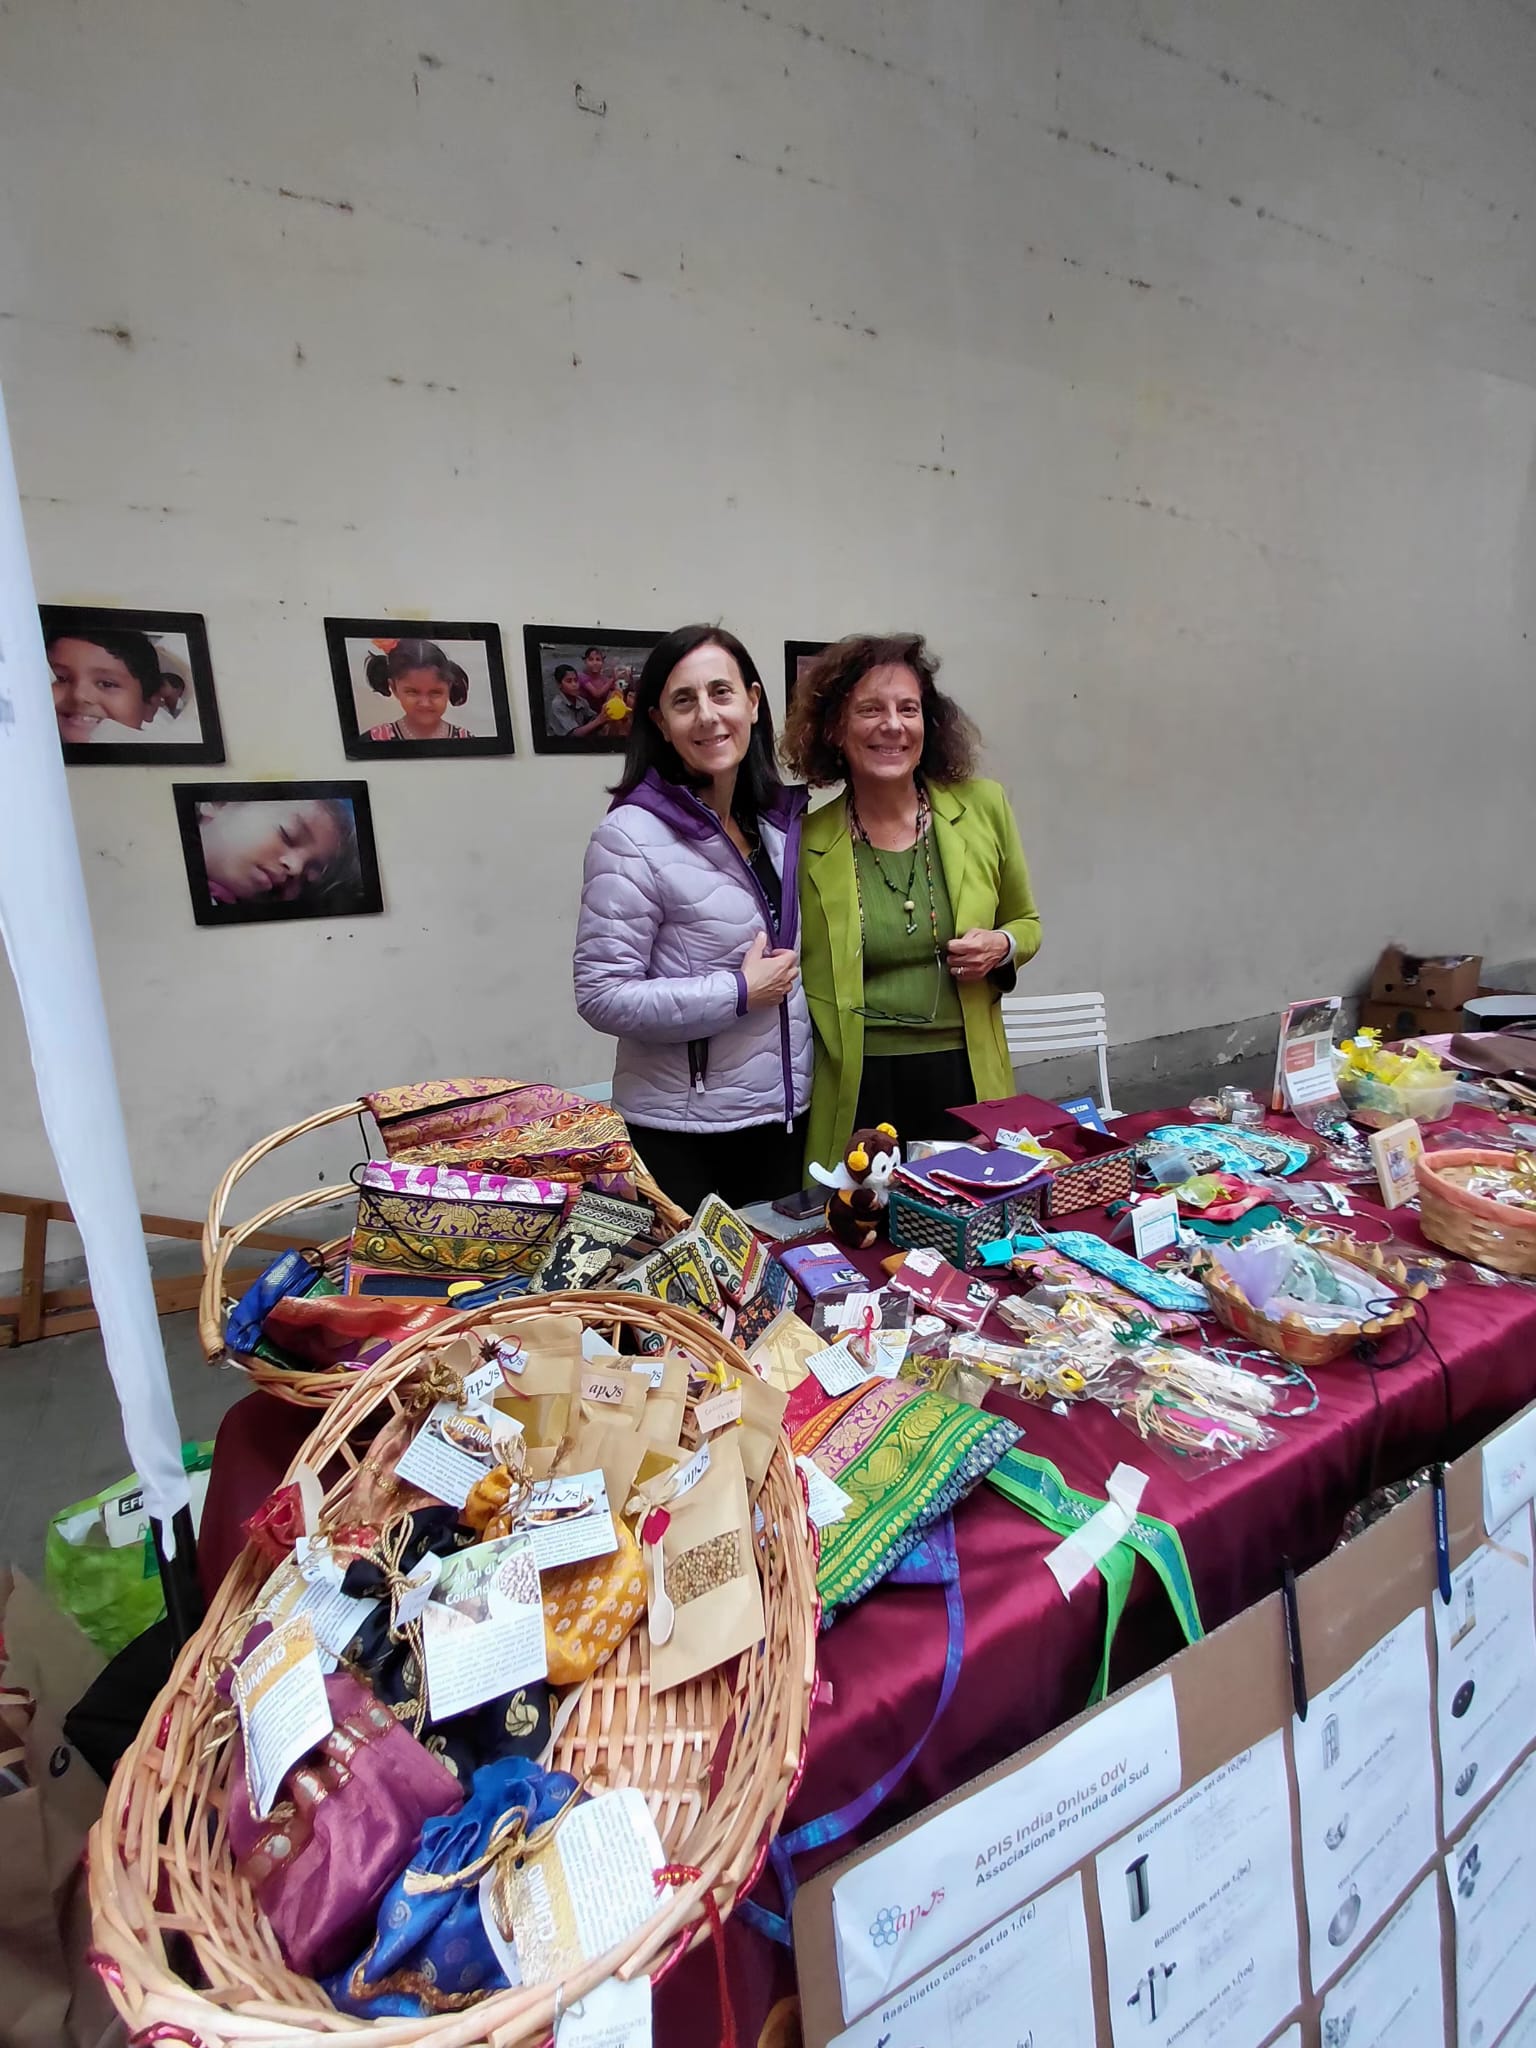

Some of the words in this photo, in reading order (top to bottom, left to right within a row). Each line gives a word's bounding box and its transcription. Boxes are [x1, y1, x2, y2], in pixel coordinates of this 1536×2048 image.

[974, 1836, 1014, 1871] APIS
[1015, 1811, 1054, 1844] India
[1056, 1783, 1099, 1817] Onlus
[1100, 1758, 1129, 1788] OdV
[975, 1828, 1056, 1887] Associazione
[1058, 1814, 1079, 1832] Pro
[1081, 1795, 1109, 1821] India
[1110, 1779, 1127, 1801] del
[1128, 1762, 1151, 1785] Sud
[1137, 1811, 1173, 1844] Bicchieri
[527, 1863, 558, 1942] CUMINO
[882, 1978, 941, 2025] Raschietto
[942, 1953, 977, 1981] cocco,
[978, 1937, 996, 1954] set
[996, 1928, 1010, 1943] da
